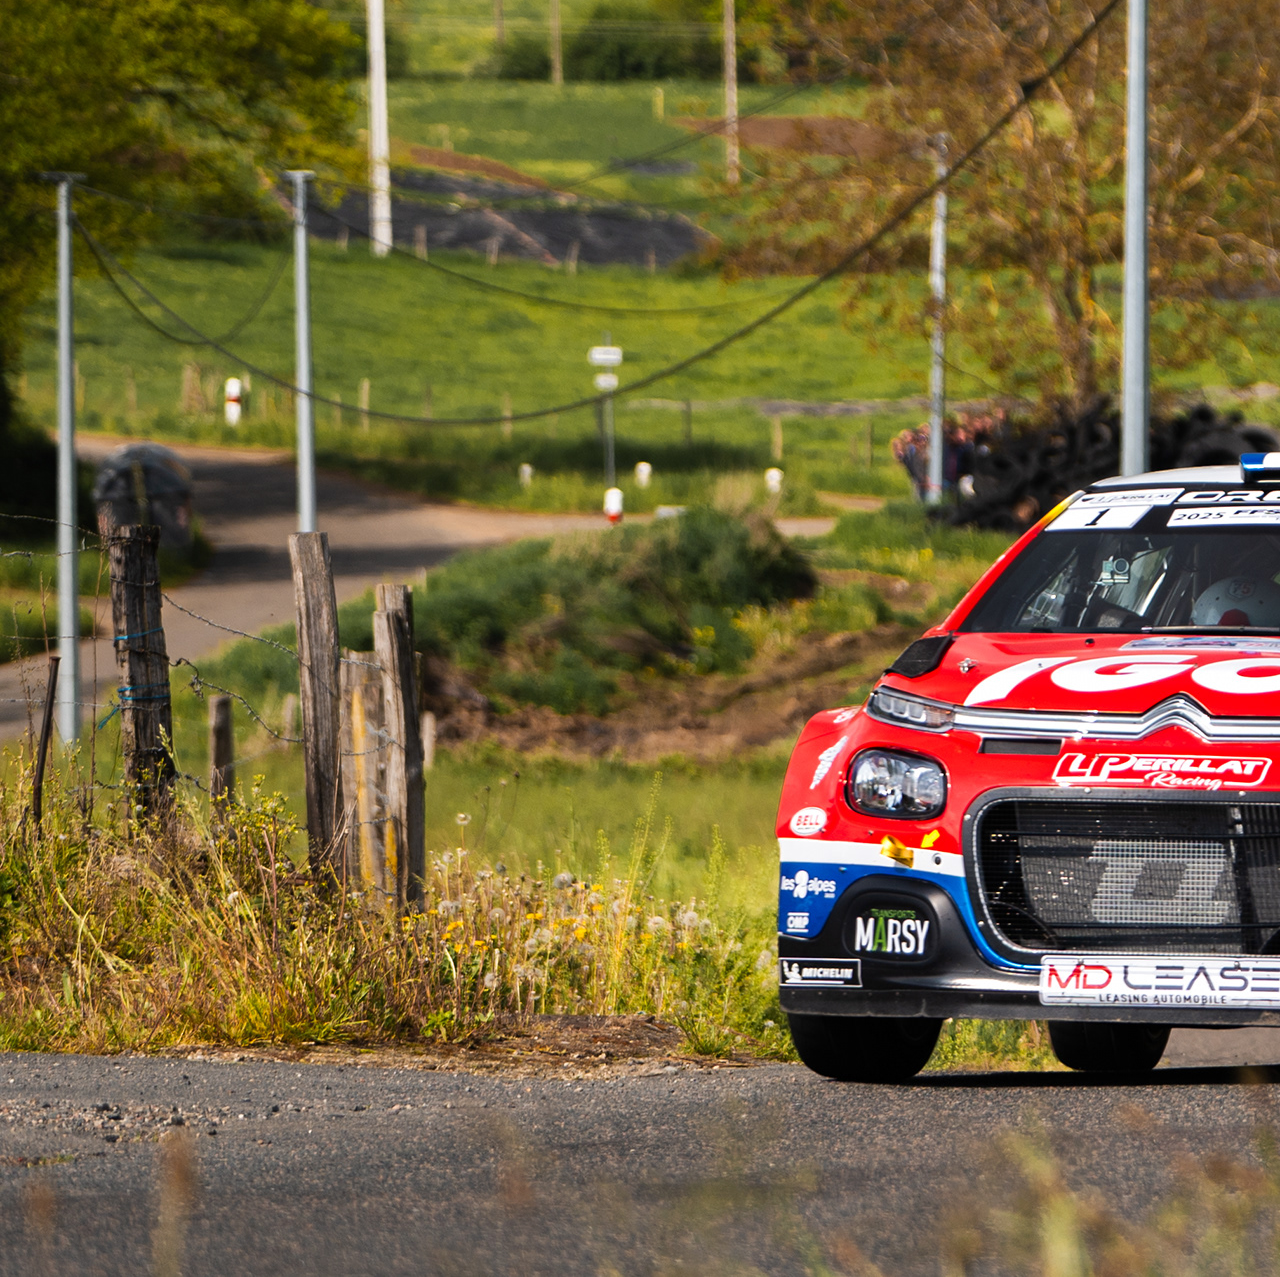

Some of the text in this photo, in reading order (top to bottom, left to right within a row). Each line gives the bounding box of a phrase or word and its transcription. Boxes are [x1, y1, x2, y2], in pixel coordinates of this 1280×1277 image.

[1084, 507, 1112, 527] 1
[1174, 511, 1227, 521] 2025
[1144, 771, 1224, 791] Racing
[796, 814, 820, 827] BELL
[781, 875, 795, 891] les
[808, 877, 837, 895] alpes
[870, 908, 917, 919] TRANSPORTS
[855, 916, 930, 955] MARSY
[801, 967, 854, 979] MICHELIN
[1047, 964, 1280, 992] MD LEASE
[1098, 993, 1228, 1004] LEASING AUTOMOBILE
